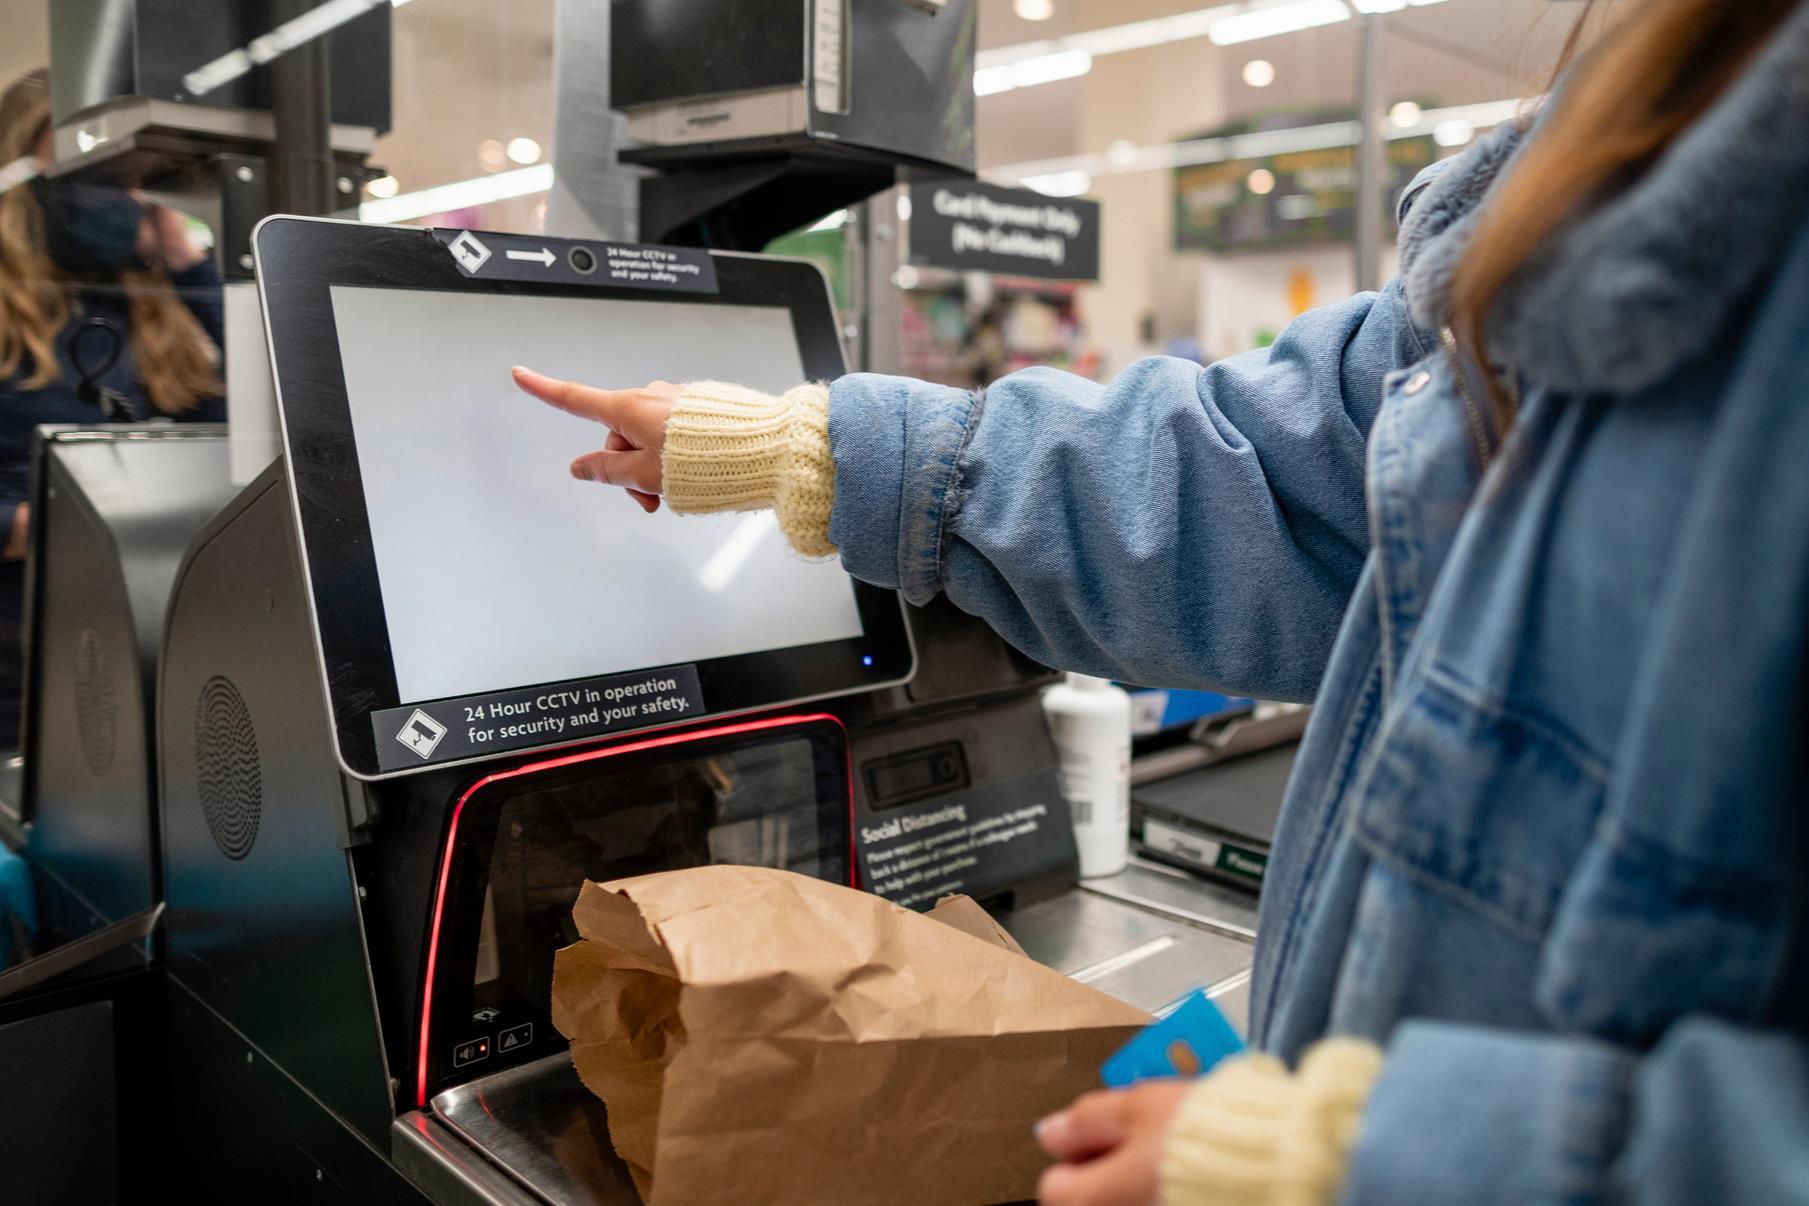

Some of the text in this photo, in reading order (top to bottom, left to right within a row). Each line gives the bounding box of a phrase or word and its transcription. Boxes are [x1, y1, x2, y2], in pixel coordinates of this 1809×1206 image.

[932, 188, 1082, 239] Card Payment Only
[607, 247, 677, 261] 24 Hour CCTV in
[608, 259, 700, 276] operation for security
[611, 270, 677, 284] and your safety.
[464, 678, 677, 723] 24 Hour CCTV in operation
[467, 695, 690, 744] for security and your safety.
[861, 804, 968, 844] Social Distancing
